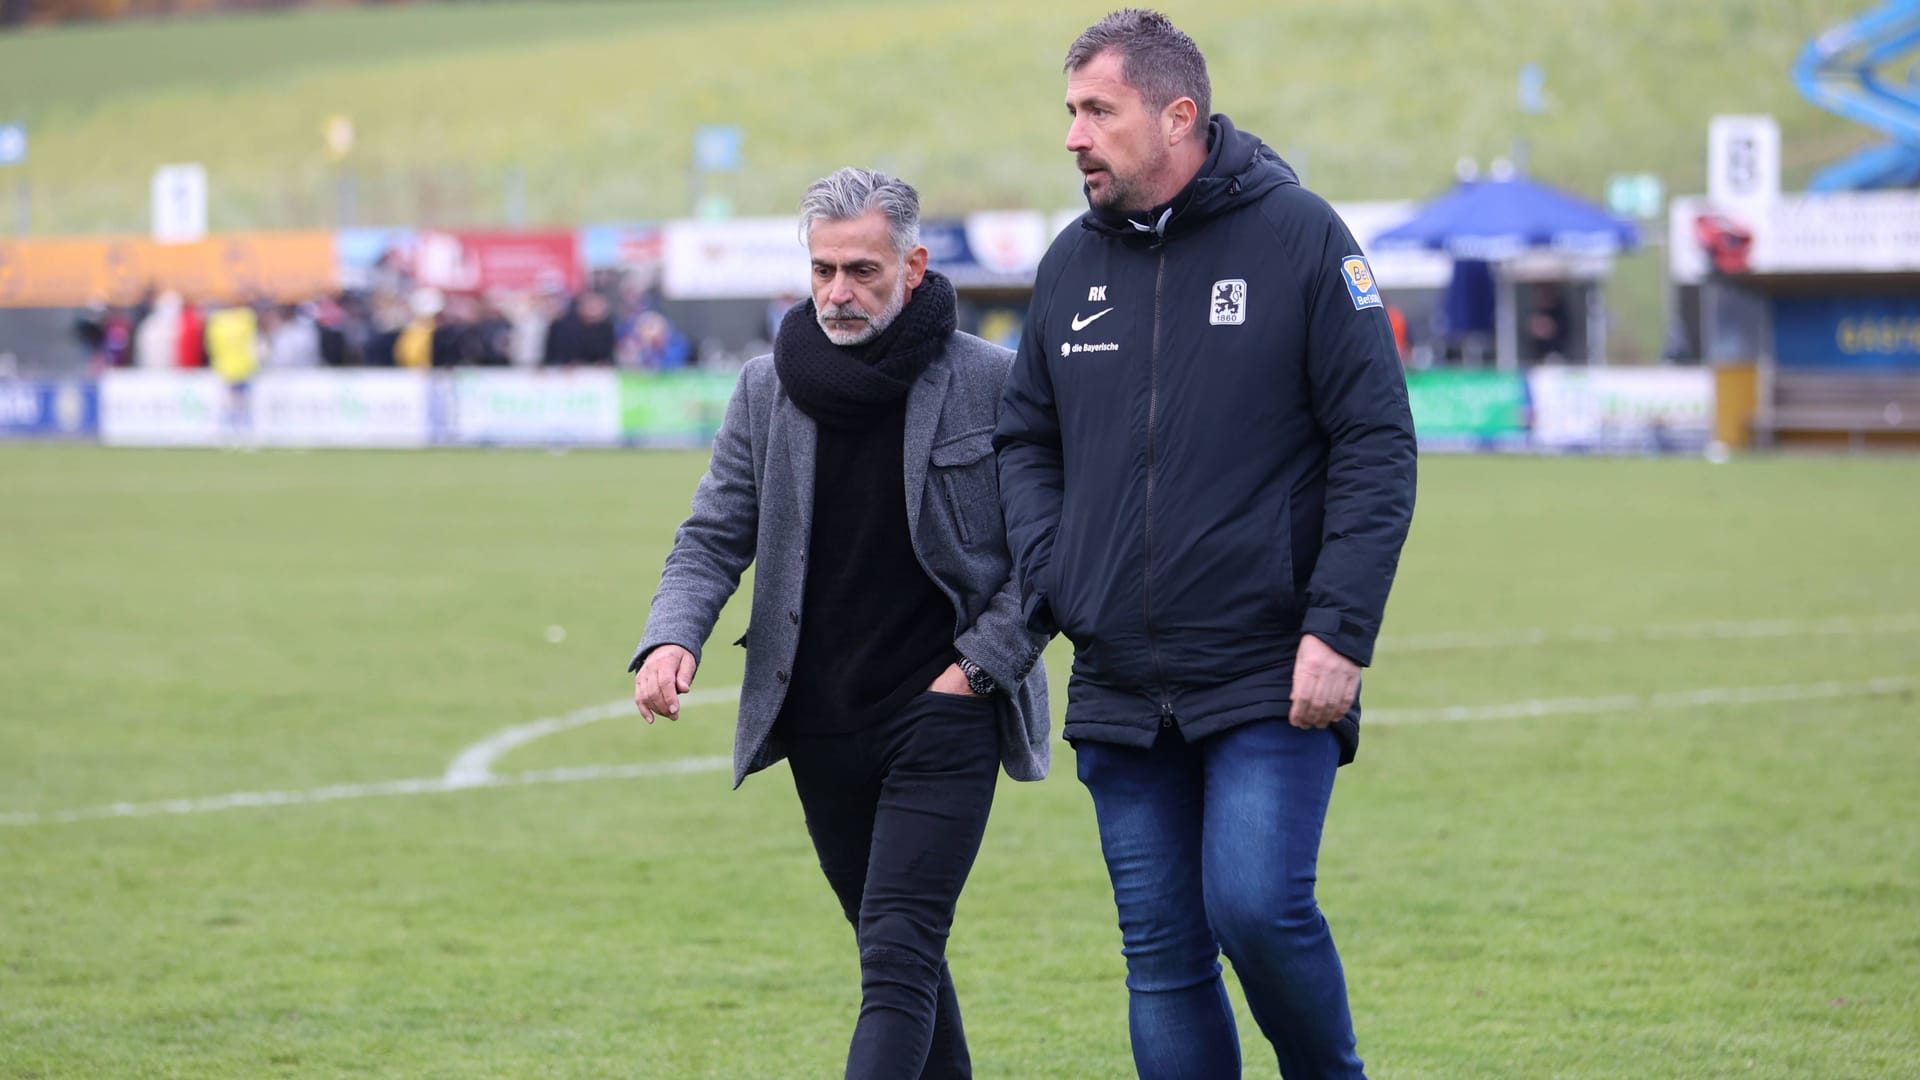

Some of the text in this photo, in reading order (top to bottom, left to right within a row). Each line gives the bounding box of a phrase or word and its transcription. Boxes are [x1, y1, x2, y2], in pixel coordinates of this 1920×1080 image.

[1089, 286, 1107, 301] RK
[1217, 314, 1237, 322] 1860
[1072, 342, 1119, 353] die Bayerische
